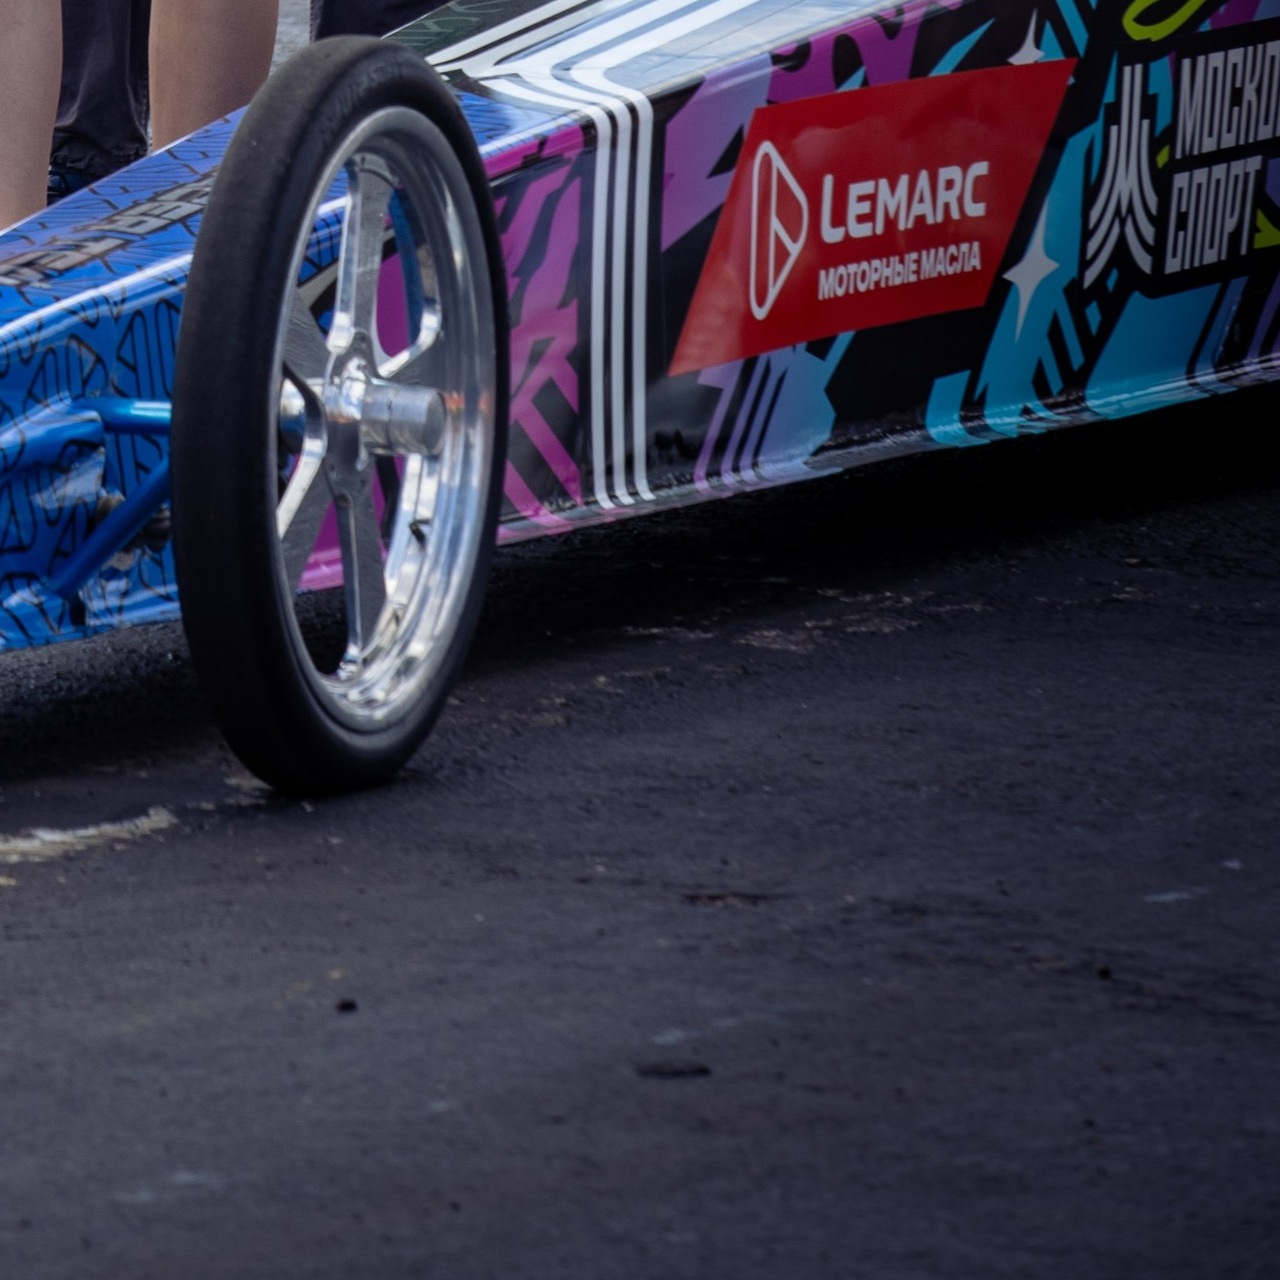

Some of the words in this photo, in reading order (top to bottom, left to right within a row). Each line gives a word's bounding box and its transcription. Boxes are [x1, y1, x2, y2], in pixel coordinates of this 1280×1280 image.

[1175, 39, 1280, 159] МОСКО
[821, 160, 990, 244] LEMARC
[1164, 154, 1263, 275] СПОРТ
[818, 251, 919, 301] МОТОРНЫЕ
[919, 240, 982, 280] МАСЛА
